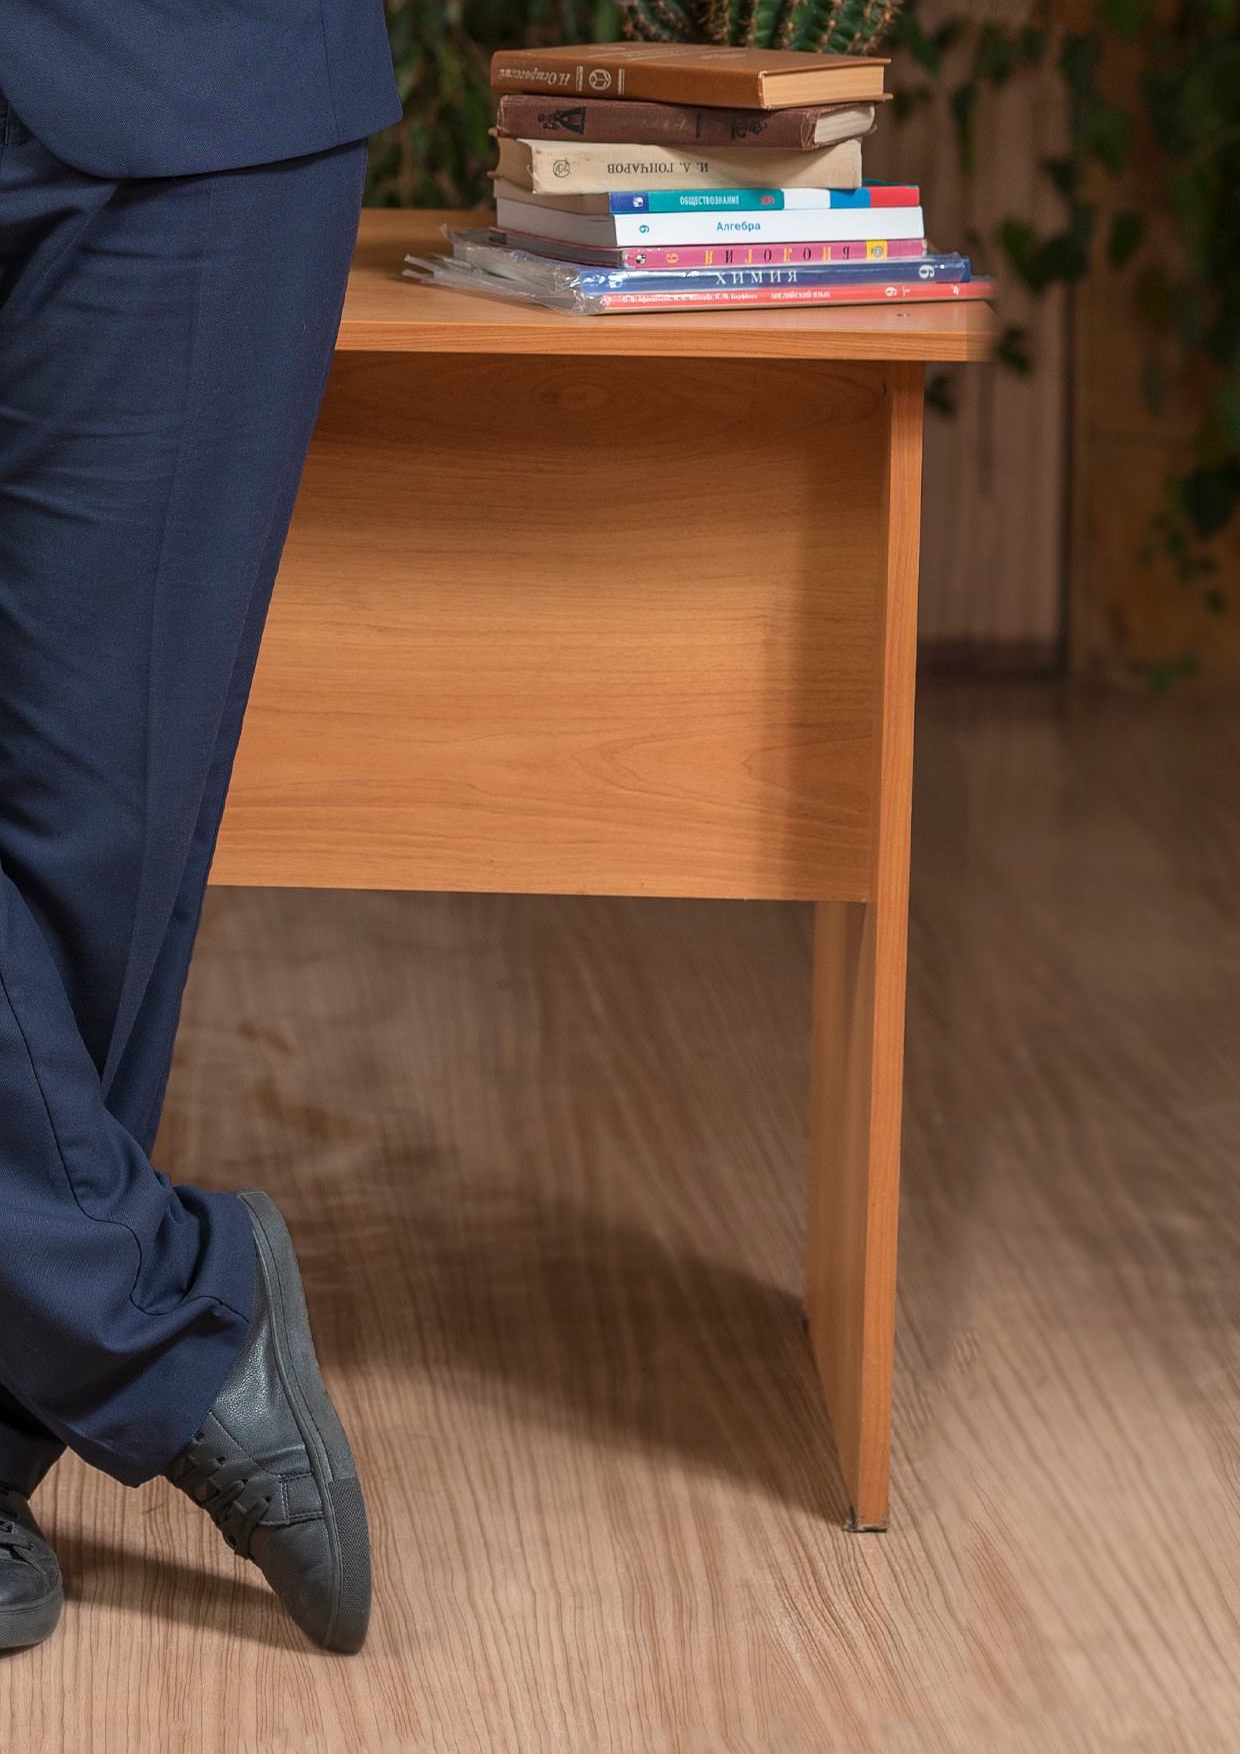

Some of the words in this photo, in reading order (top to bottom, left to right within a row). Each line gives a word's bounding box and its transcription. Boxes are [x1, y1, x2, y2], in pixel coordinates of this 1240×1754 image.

[607, 162, 674, 175] ГОНЧАРОВ
[679, 195, 740, 207] ОБЩЕСТВОЗНАНИЕ
[716, 221, 761, 233] Алгебра
[704, 245, 850, 266] БИОЛОГИЯ
[715, 269, 798, 286] ХИМИЯ
